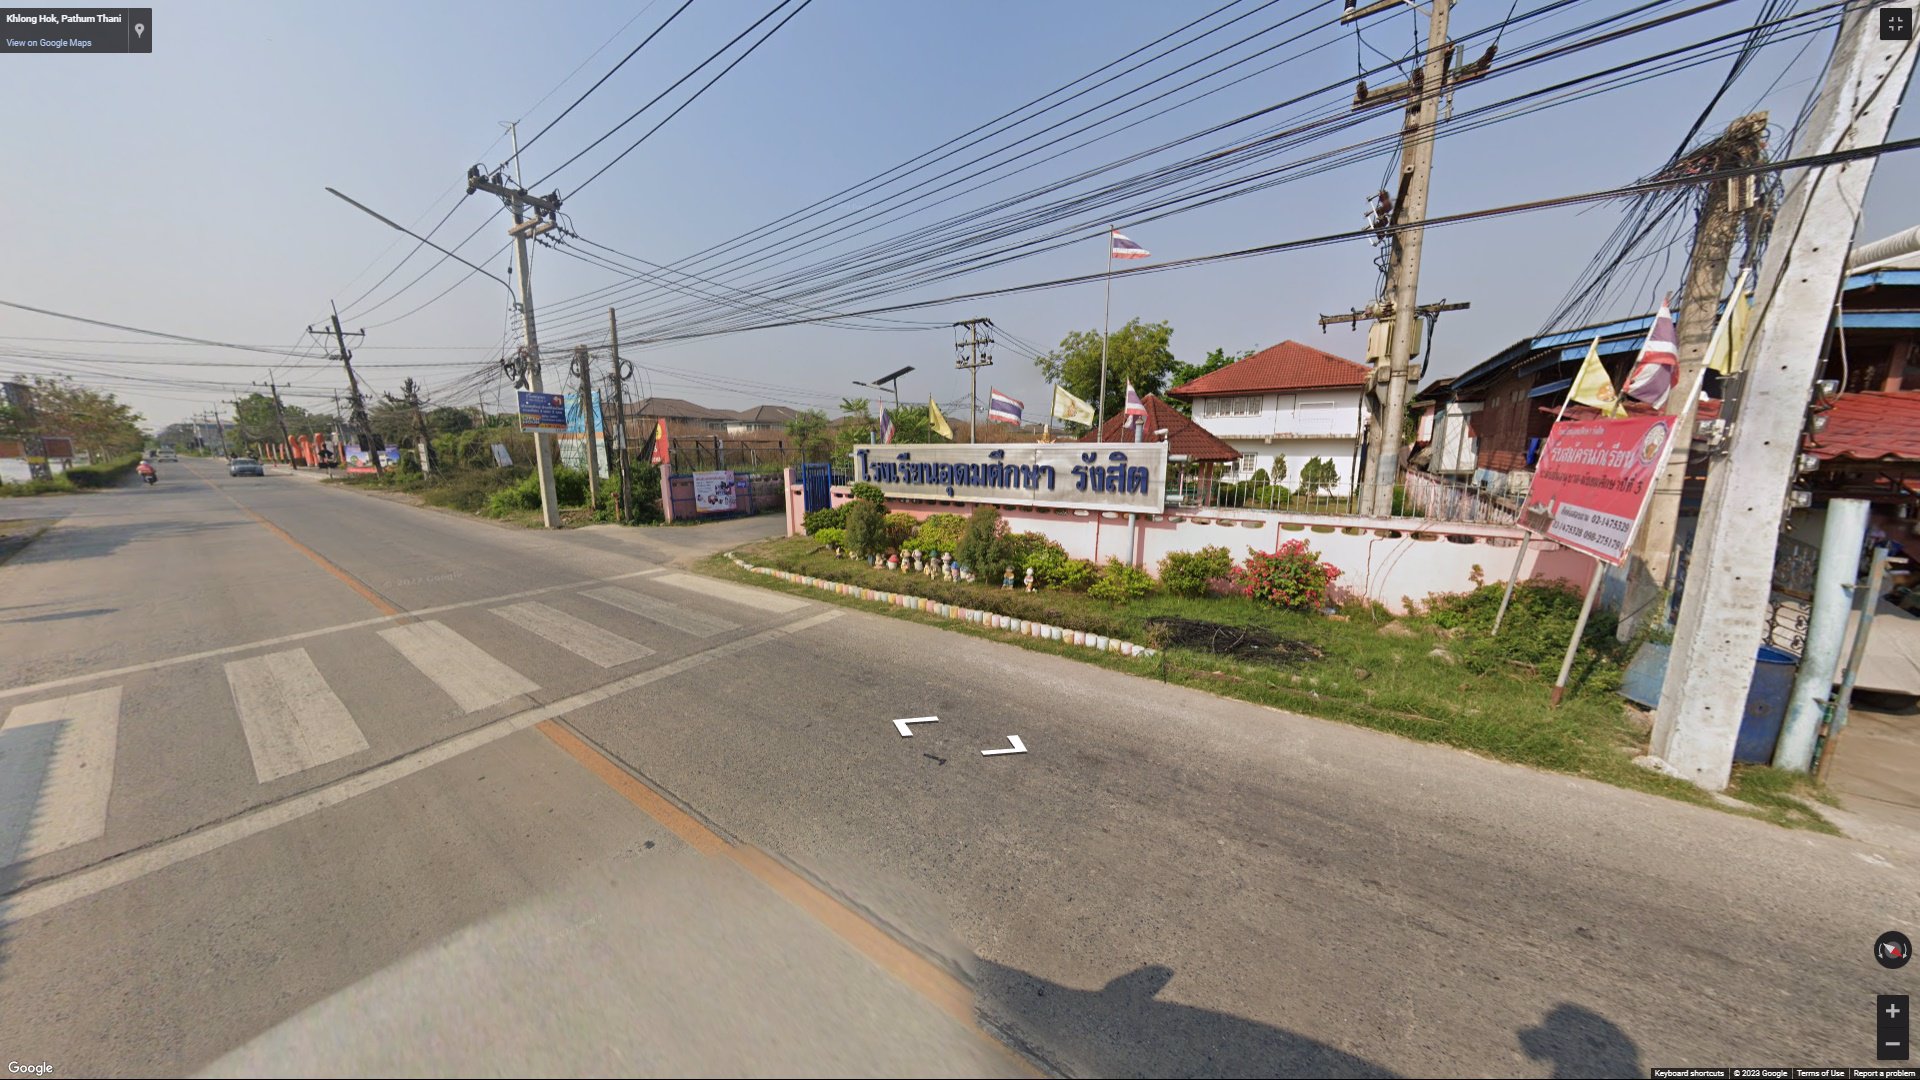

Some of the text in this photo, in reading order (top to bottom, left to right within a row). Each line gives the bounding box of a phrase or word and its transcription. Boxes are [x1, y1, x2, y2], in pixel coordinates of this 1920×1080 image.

[1551, 442, 1635, 468] รับสมัครนักเรียน
[857, 449, 1149, 497] โรงเรียนอุดมศึกษา รังสิต
[1591, 514, 1630, 533] 02-1475329
